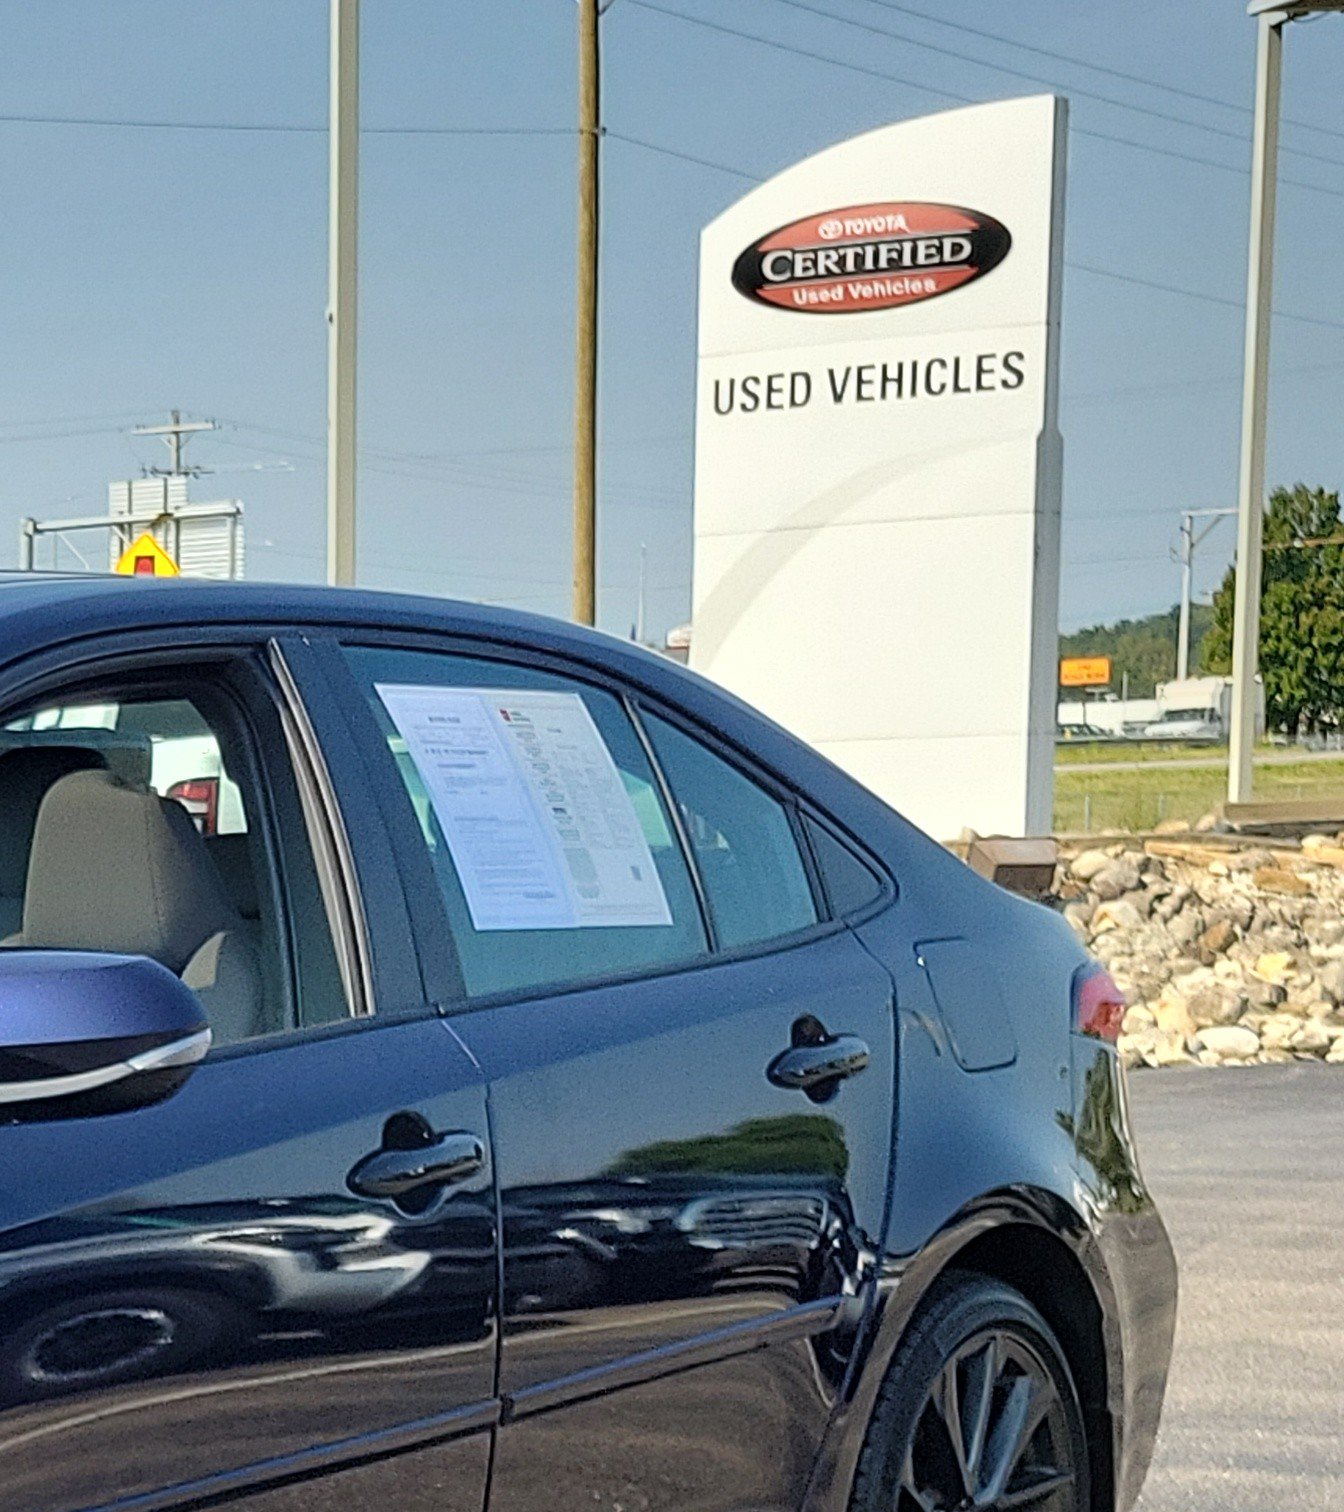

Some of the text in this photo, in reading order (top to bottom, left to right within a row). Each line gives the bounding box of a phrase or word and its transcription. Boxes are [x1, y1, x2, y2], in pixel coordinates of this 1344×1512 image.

[844, 214, 911, 235] TOYOTA
[762, 237, 972, 282] CERTIFIED
[793, 277, 937, 305] Used Vehicles
[714, 351, 1025, 415] USED VEHICLES
